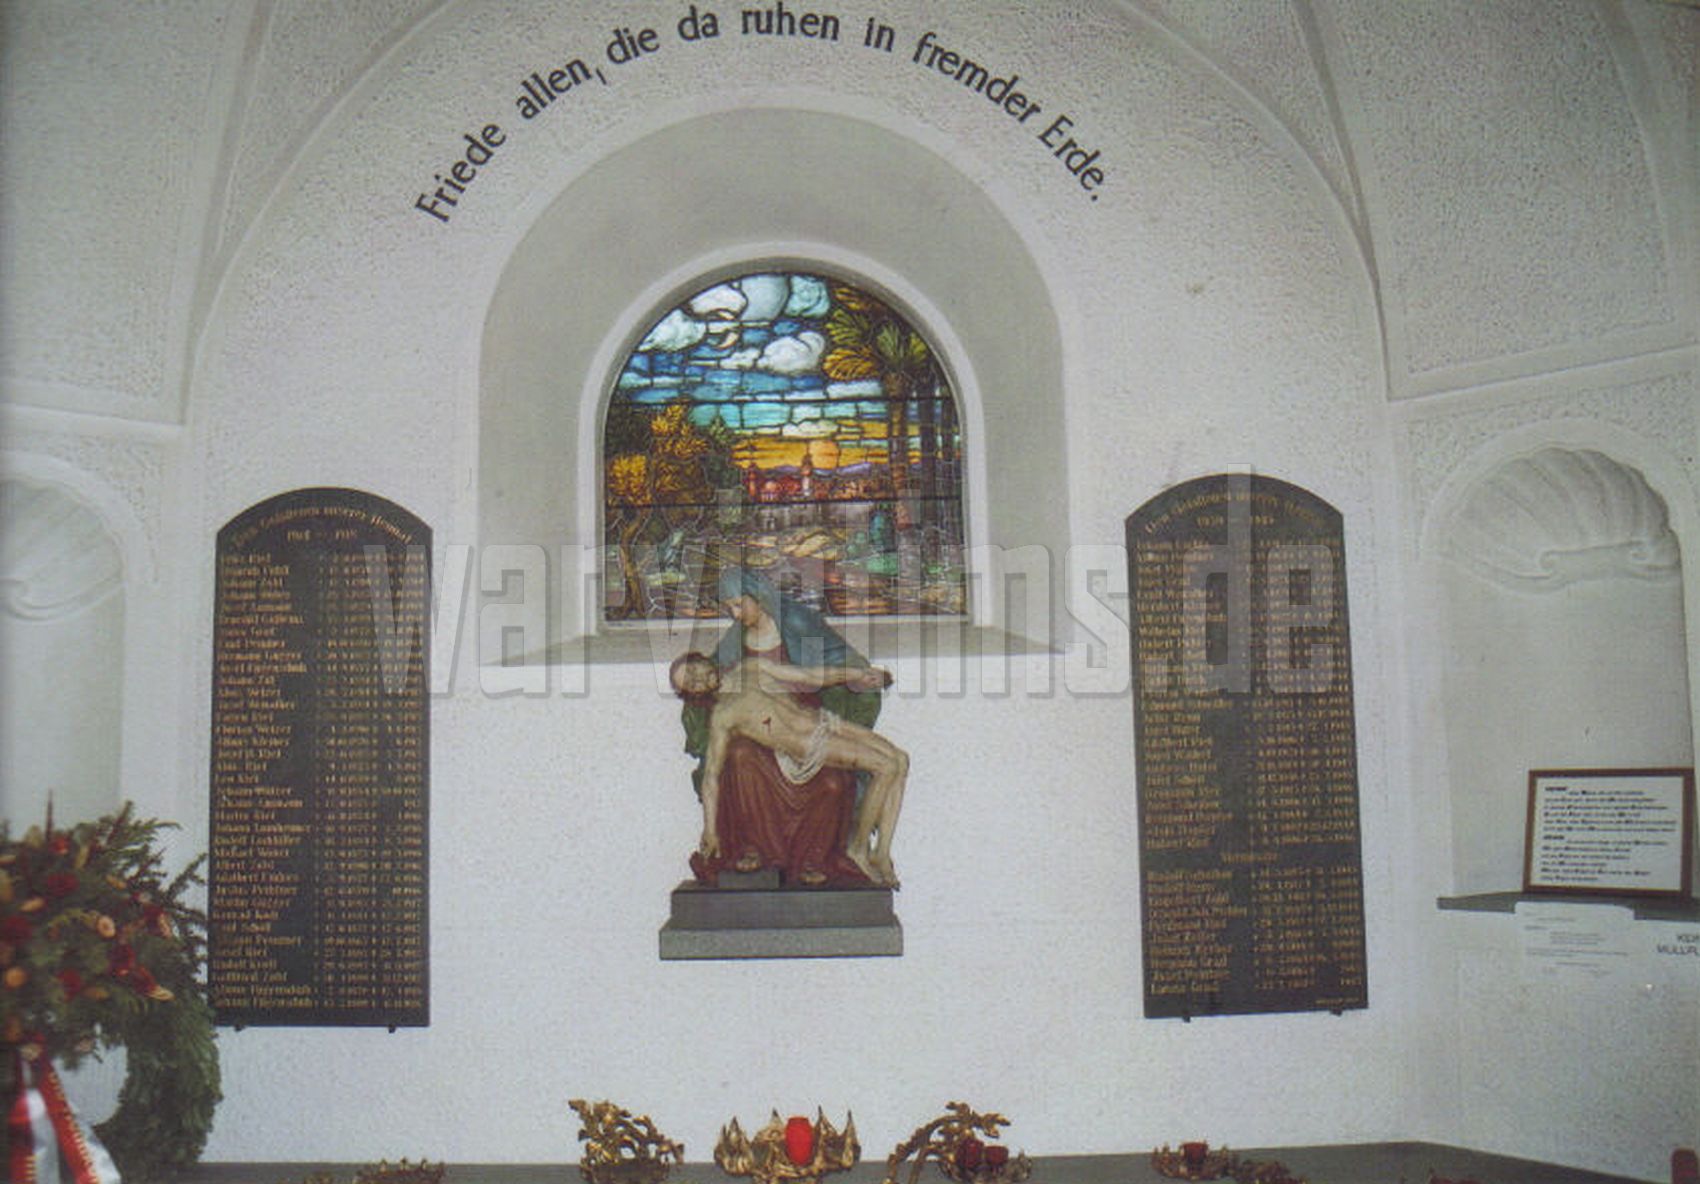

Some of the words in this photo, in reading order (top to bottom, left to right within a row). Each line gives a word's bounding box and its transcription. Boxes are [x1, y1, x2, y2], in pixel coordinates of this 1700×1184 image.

[414, 124, 507, 223] Friede
[515, 59, 607, 120] allen,
[606, 27, 660, 65] die
[677, 4, 720, 42] da
[741, 0, 840, 41] ruhen
[864, 17, 895, 53] in
[912, 31, 1041, 123] fremder
[1037, 114, 1104, 202] Erde.
